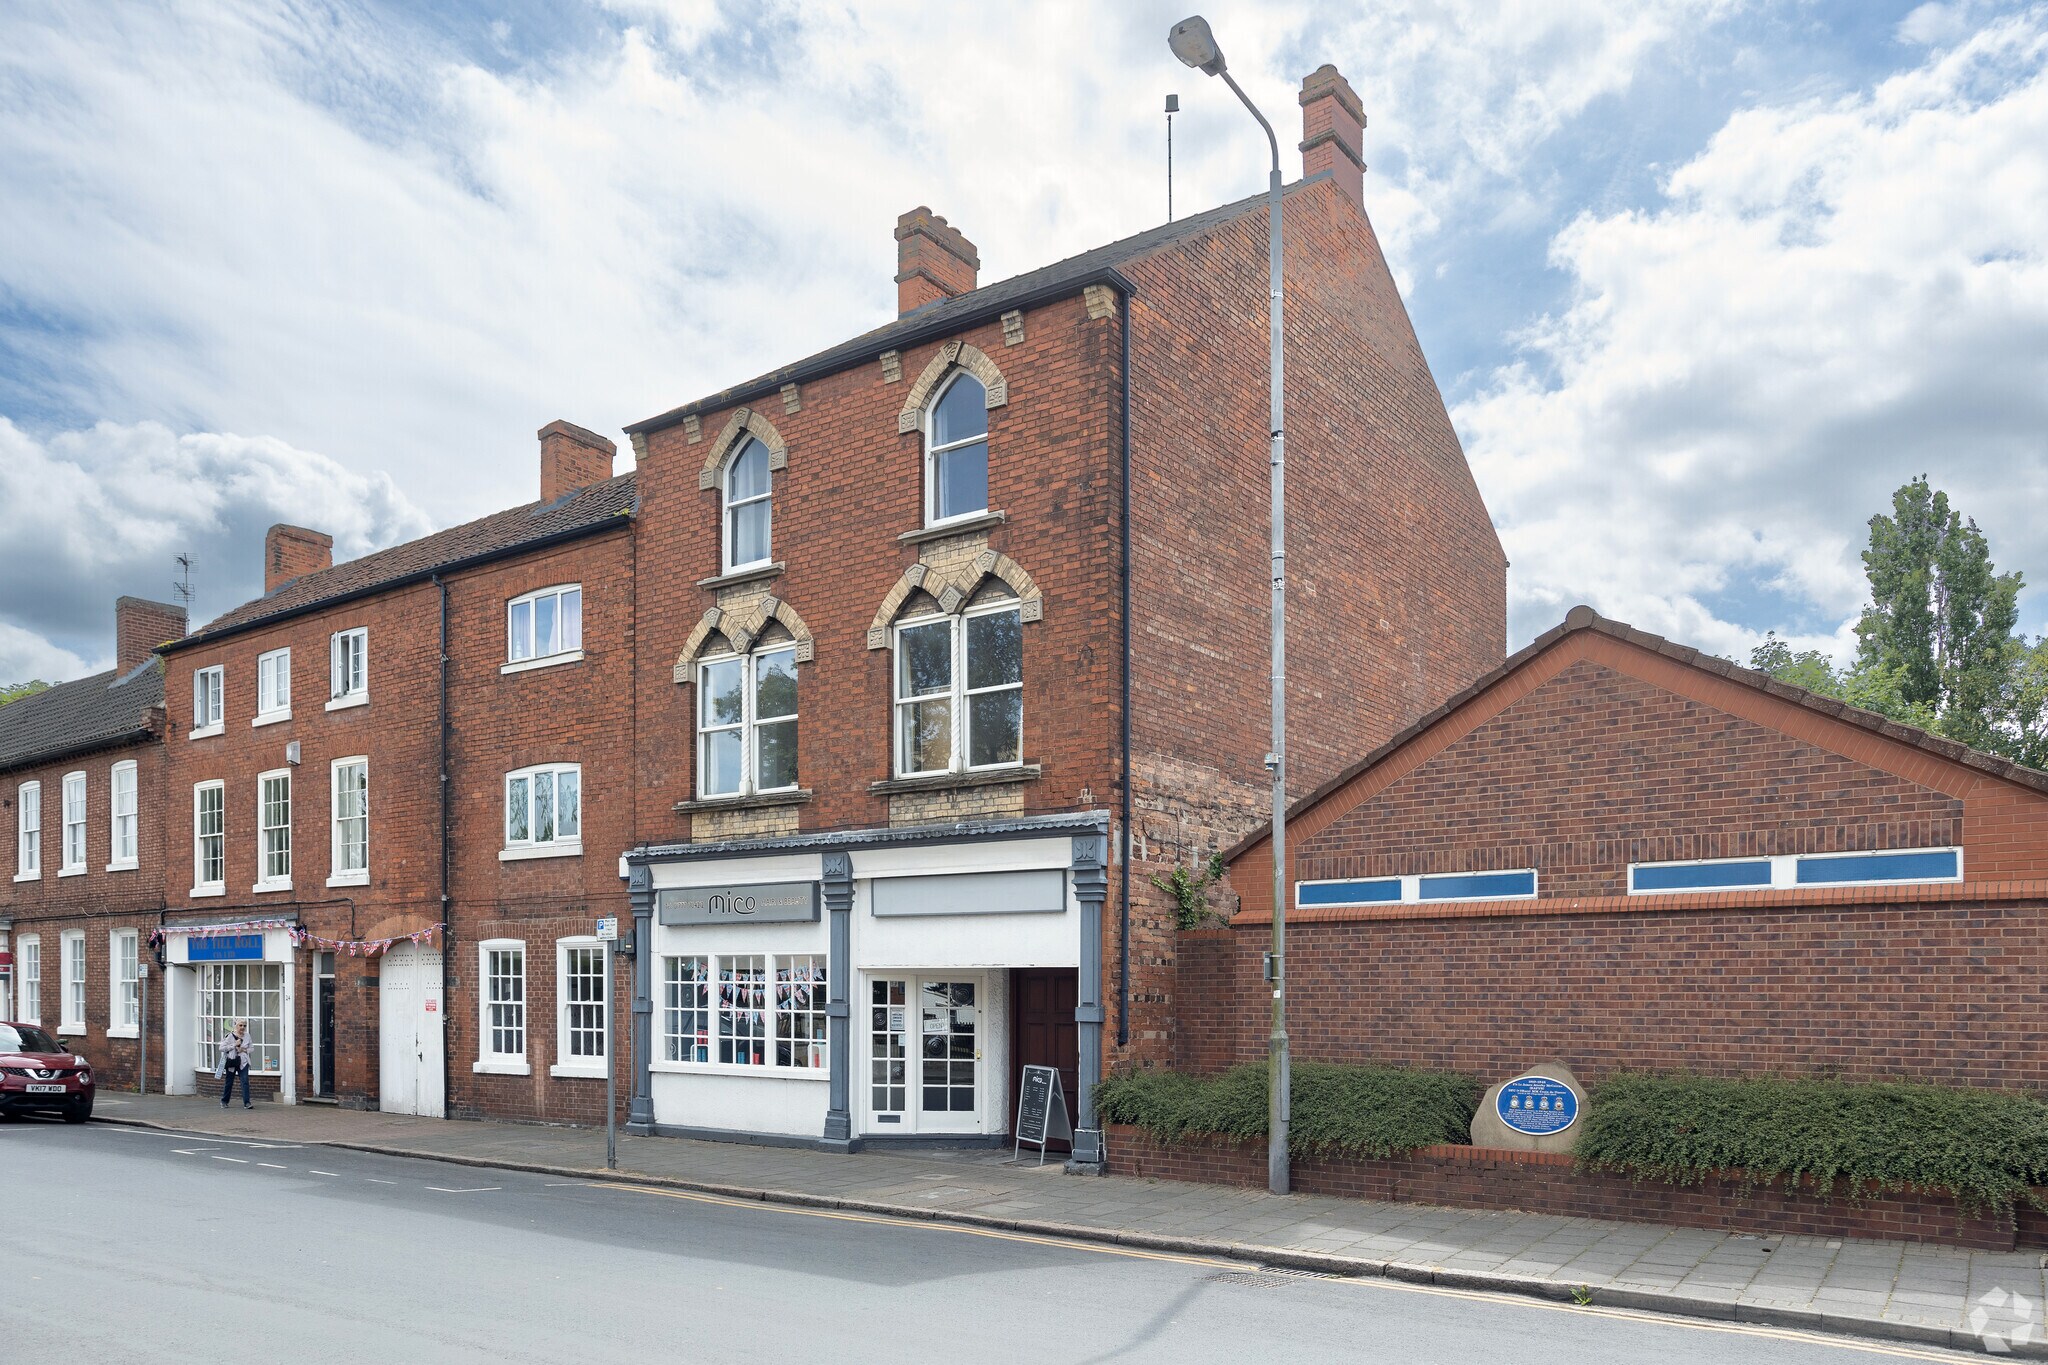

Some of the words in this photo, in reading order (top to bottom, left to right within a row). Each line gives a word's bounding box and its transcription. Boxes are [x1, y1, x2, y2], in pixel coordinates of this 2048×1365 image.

[708, 890, 756, 915] mico
[212, 937, 232, 950] TILL
[235, 936, 260, 949] ROLL
